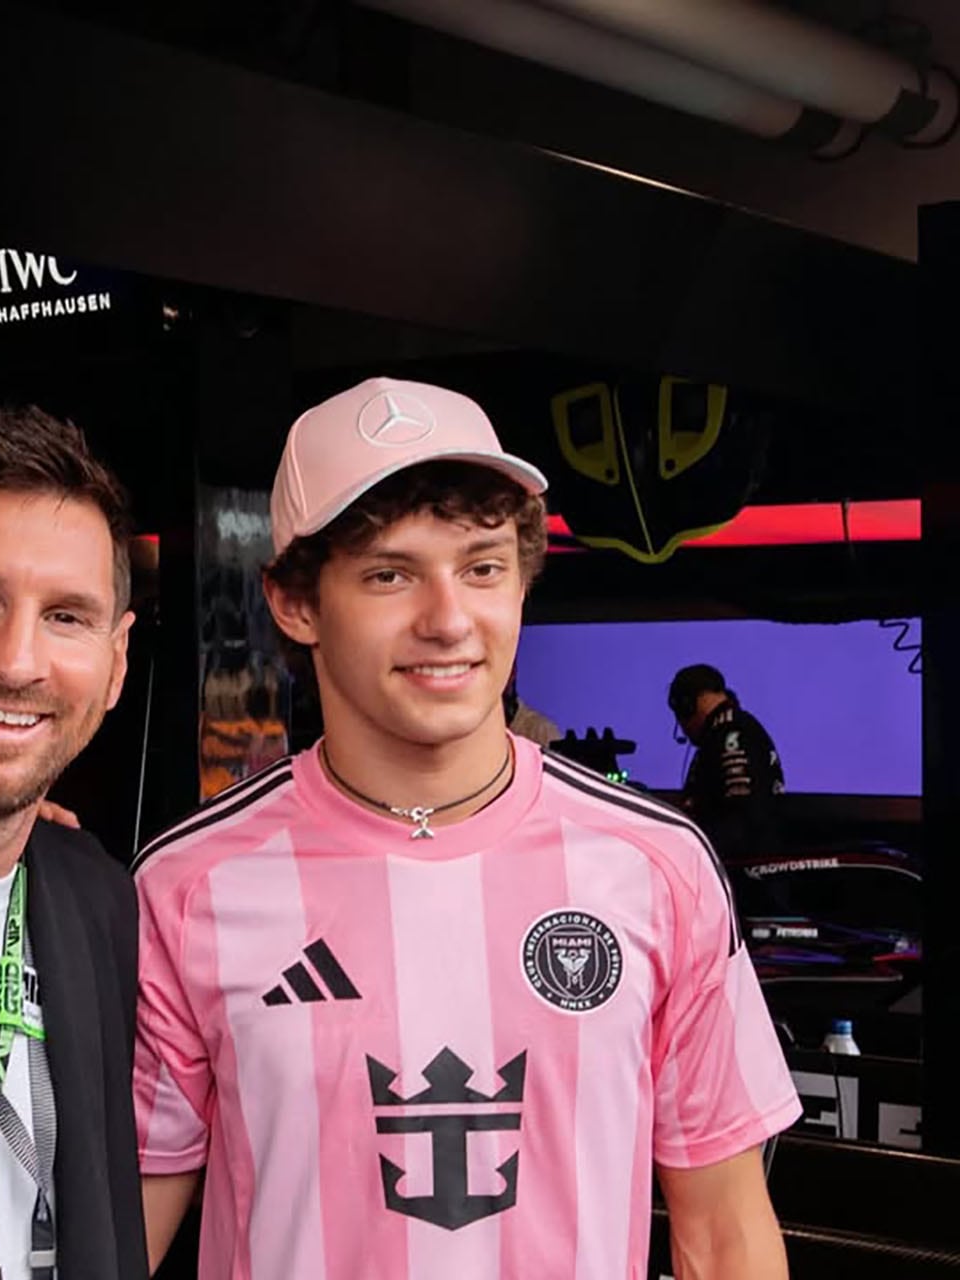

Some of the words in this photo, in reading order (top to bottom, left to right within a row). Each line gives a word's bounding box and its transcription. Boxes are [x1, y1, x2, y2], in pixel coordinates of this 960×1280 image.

[749, 858, 841, 878] CROWDSTRIKE
[6, 916, 21, 948] VIP
[552, 938, 592, 947] MIAMI
[4, 962, 21, 1014] GRID
